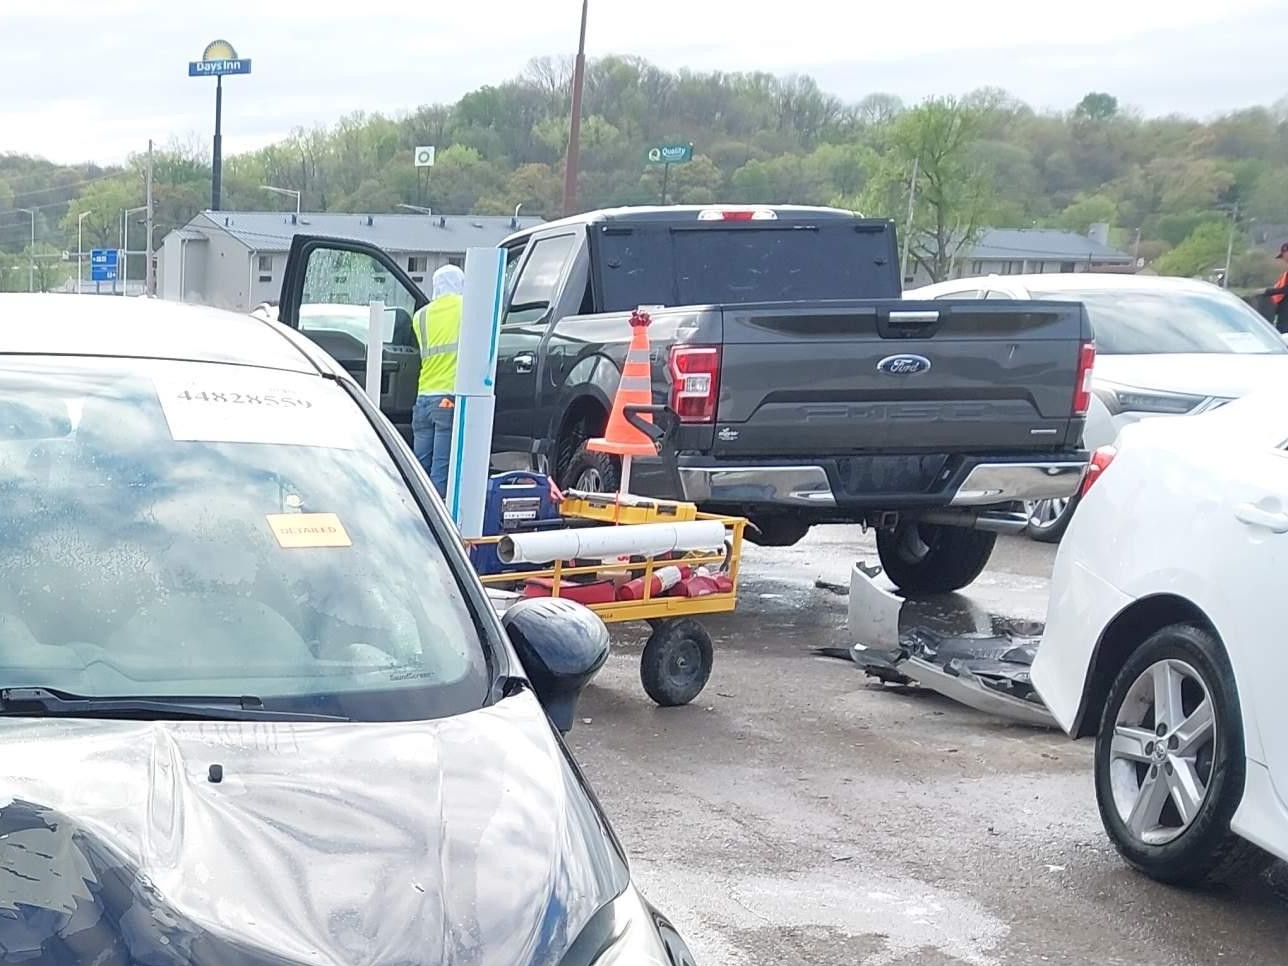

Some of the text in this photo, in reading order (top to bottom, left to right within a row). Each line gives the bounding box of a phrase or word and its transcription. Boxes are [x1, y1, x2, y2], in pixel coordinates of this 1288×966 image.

[197, 60, 241, 72] Days Inn
[662, 147, 686, 157] Quality
[890, 358, 920, 373] Ford
[176, 389, 312, 409] 44828559
